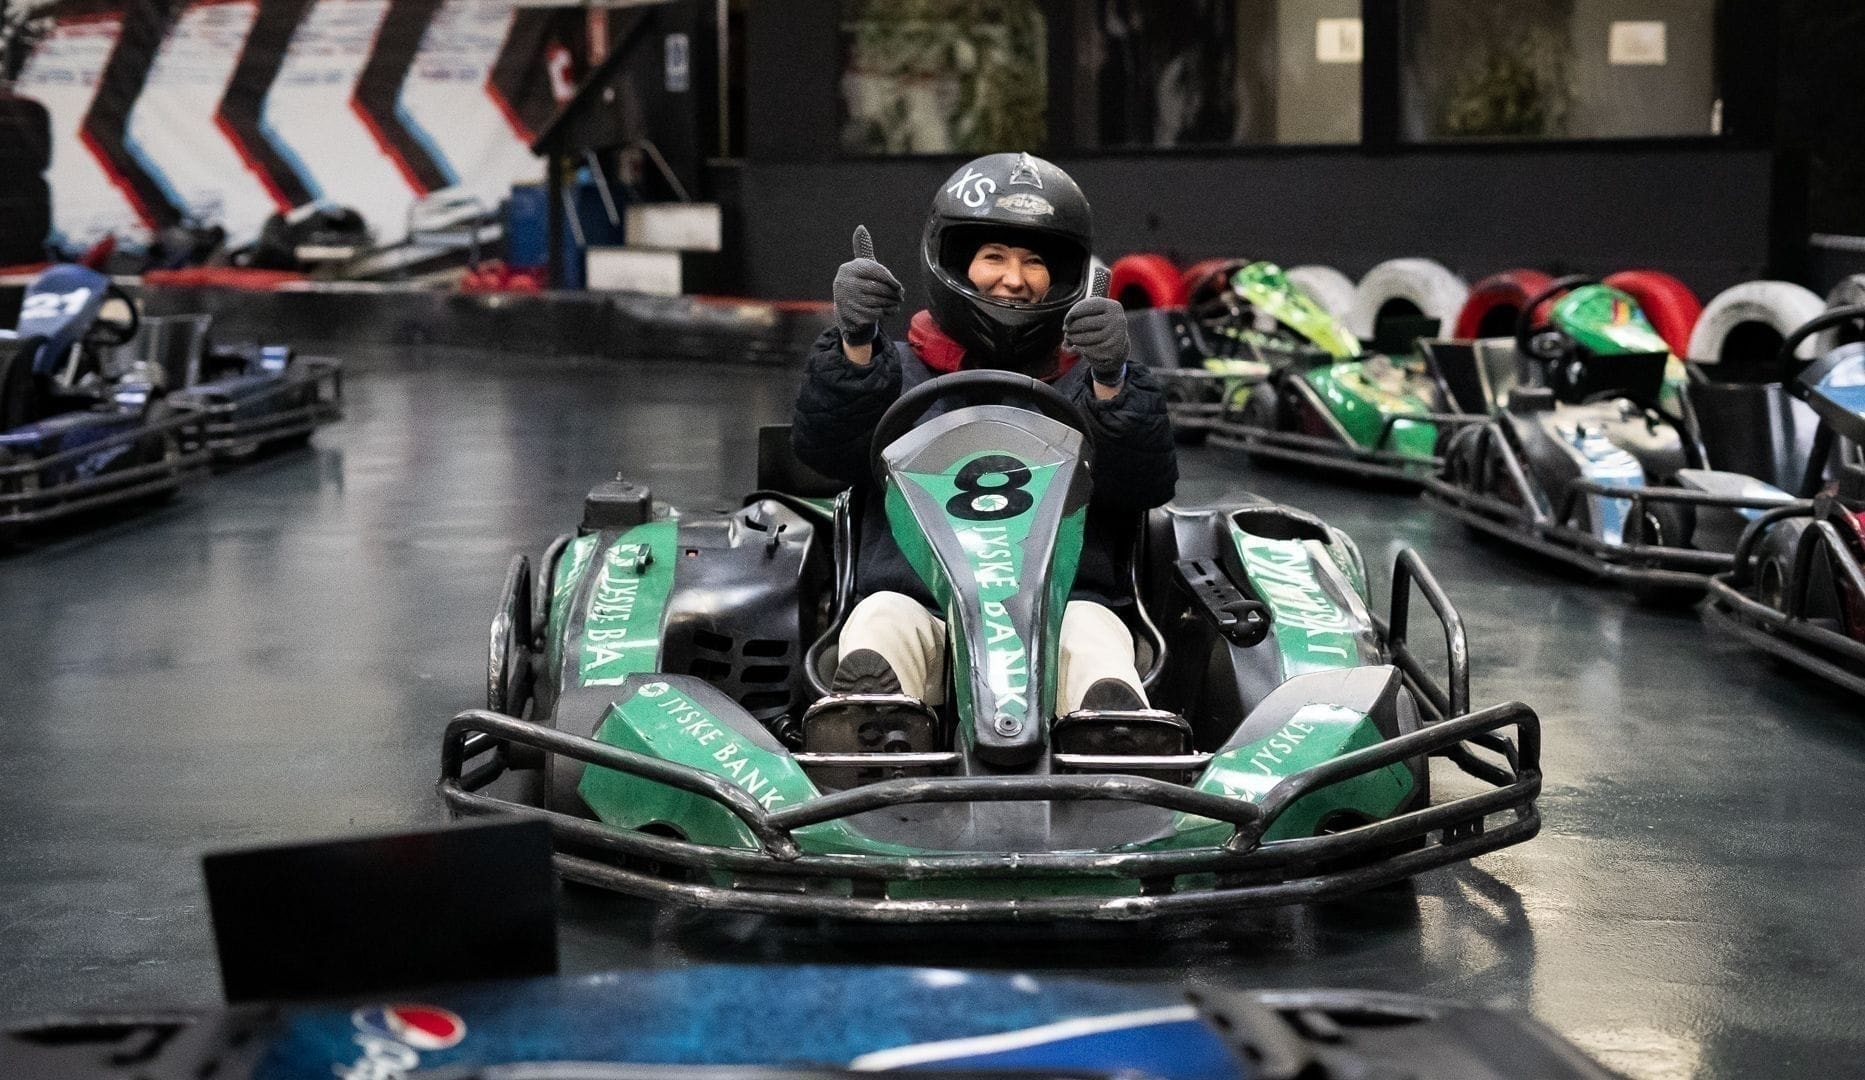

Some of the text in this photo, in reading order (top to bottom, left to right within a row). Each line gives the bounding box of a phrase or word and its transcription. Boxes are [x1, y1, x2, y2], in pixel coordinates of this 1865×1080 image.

[947, 167, 997, 208] XS
[20, 287, 92, 320] 21
[945, 454, 1034, 521] 8
[972, 526, 1018, 588] JYSKE
[588, 577, 640, 623] JYSKE
[657, 697, 785, 809] JYSKE BANK
[1250, 720, 1315, 776] JYSKE
